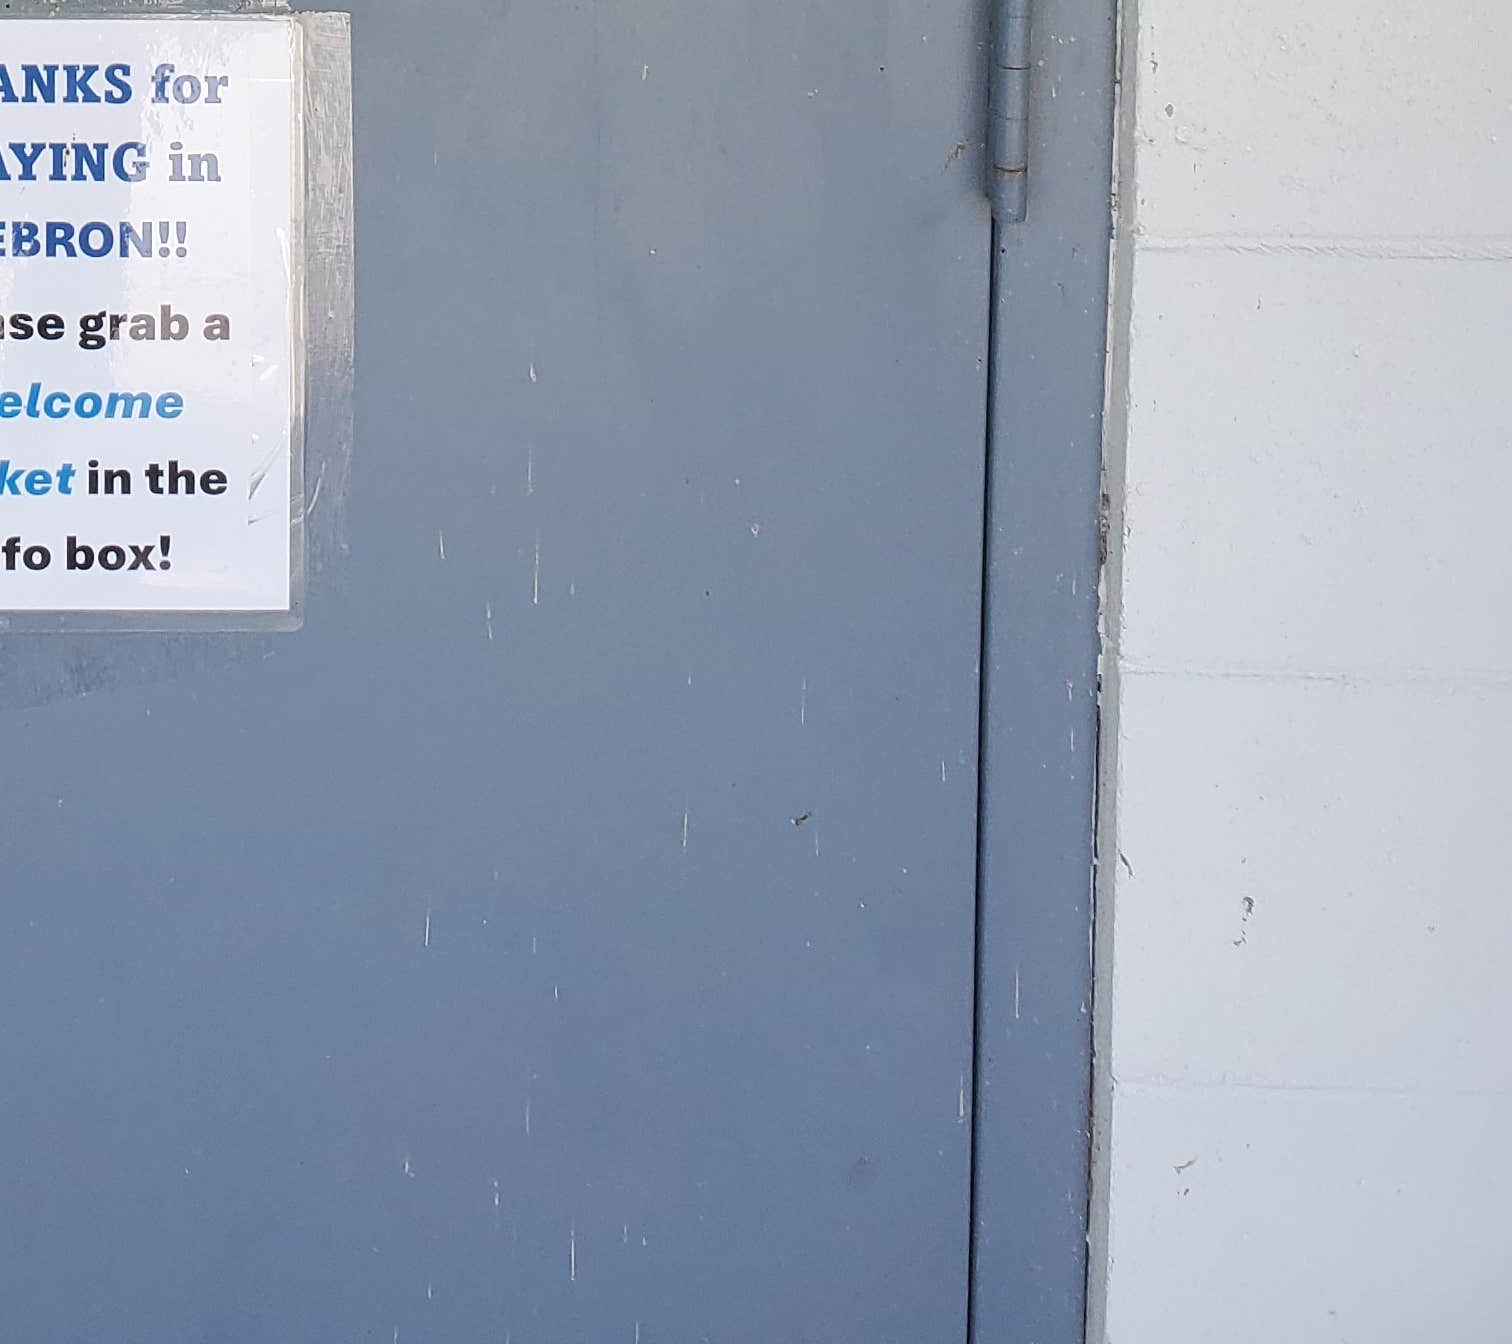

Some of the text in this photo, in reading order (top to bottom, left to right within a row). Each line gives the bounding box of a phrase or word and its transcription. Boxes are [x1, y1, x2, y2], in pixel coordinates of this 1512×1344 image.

[151, 64, 228, 104] for
[169, 142, 221, 182] in
[79, 305, 188, 350] grab
[204, 314, 230, 340] a
[89, 460, 131, 494] in
[145, 461, 227, 495] the
[67, 536, 170, 570] box!
